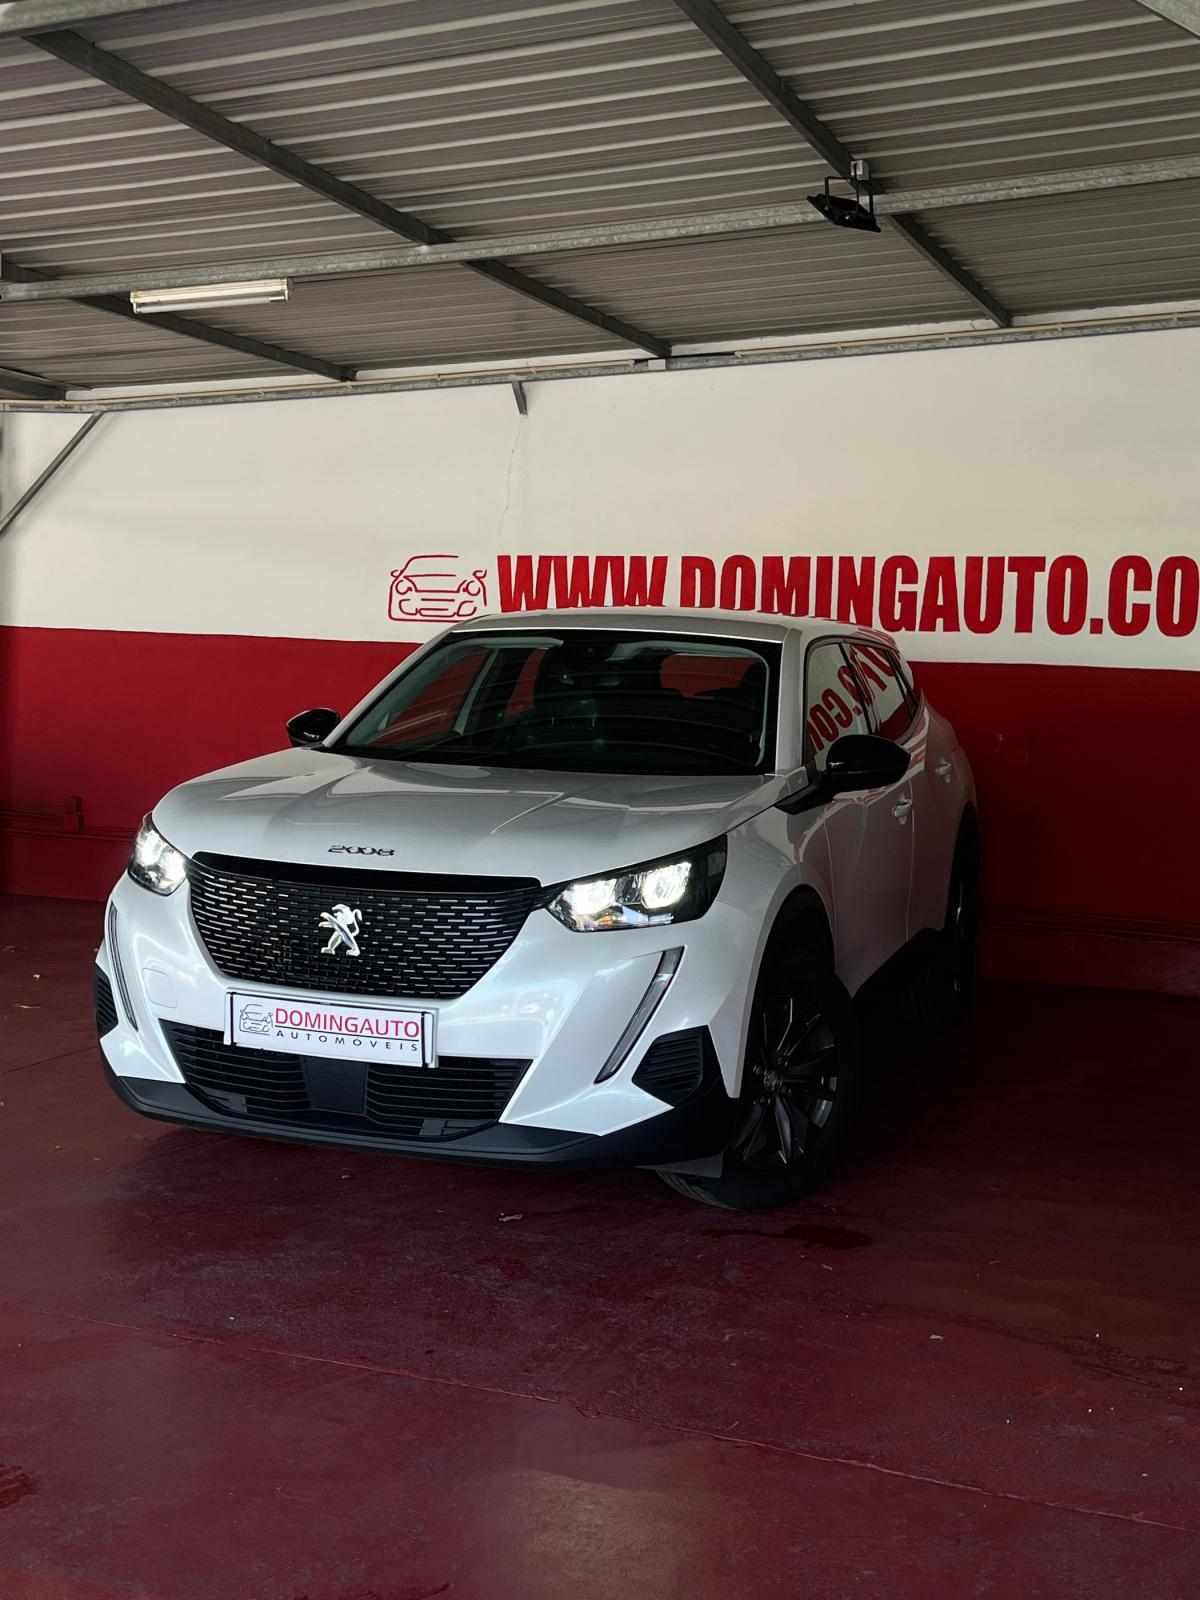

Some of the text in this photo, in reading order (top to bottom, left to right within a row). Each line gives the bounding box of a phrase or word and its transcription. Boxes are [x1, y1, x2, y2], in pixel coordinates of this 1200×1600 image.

[497, 554, 1199, 637] WWWDOMINGAUTO.CO
[328, 845, 395, 856] 2008
[275, 1008, 420, 1037] DOMINGAUTO
